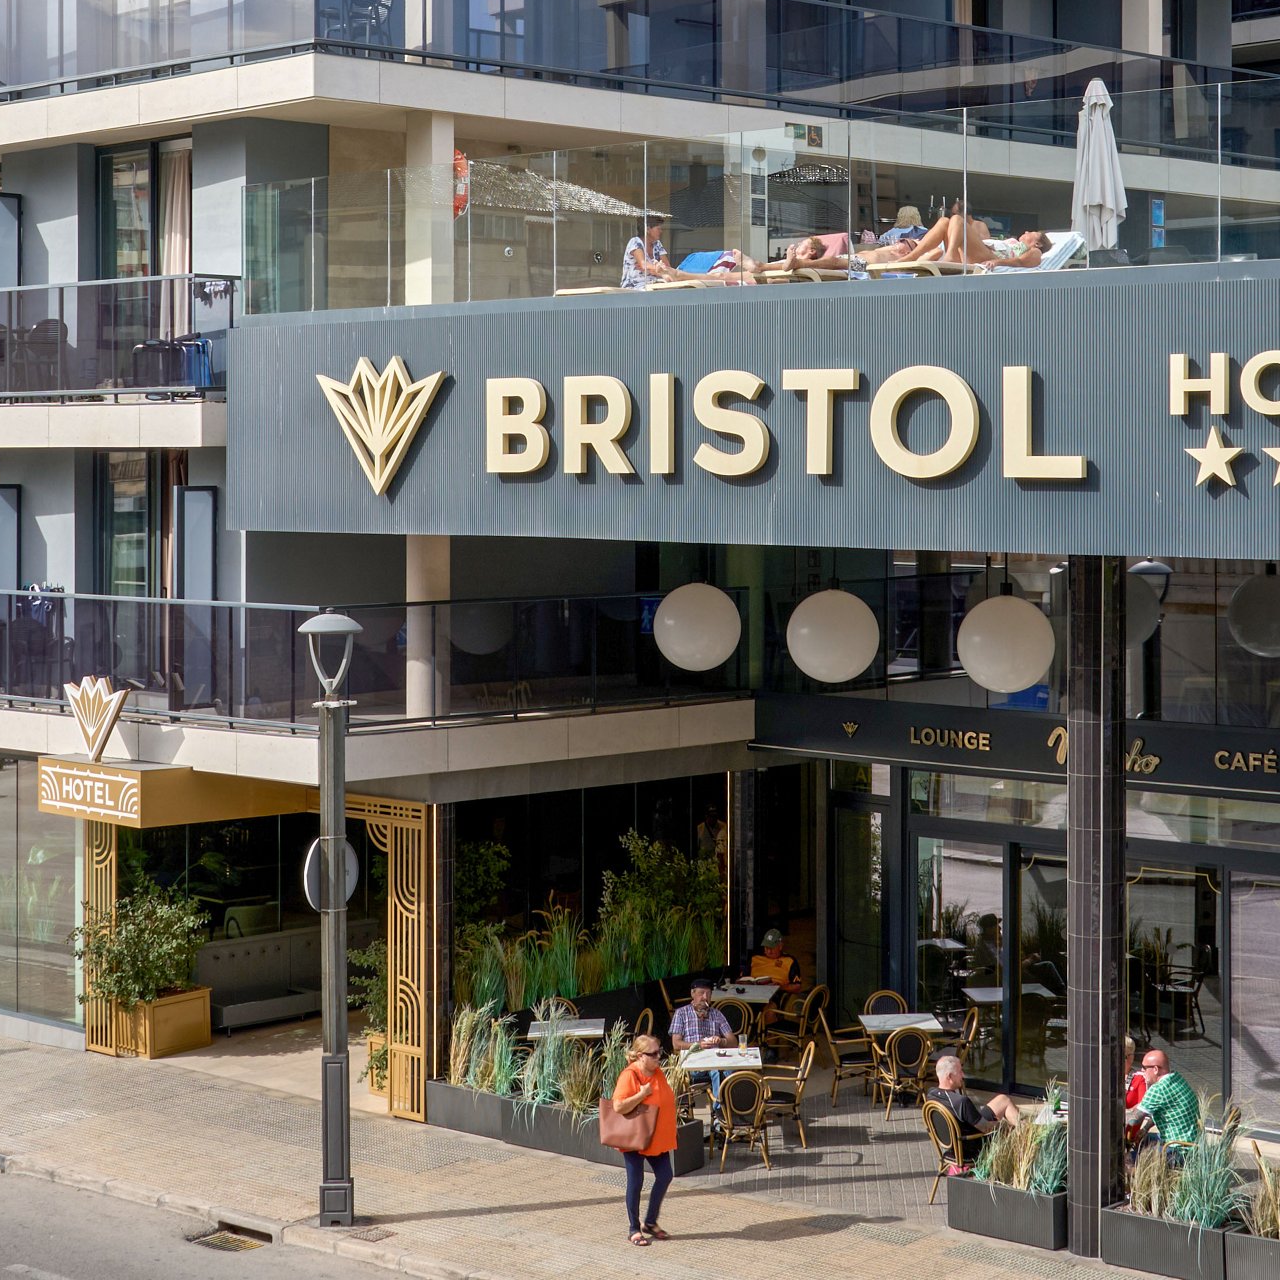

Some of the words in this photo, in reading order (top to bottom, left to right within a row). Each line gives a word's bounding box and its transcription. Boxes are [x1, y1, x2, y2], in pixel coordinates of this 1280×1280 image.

[484, 365, 1088, 483] BRISTOL
[908, 725, 992, 752] LOUNGE
[1213, 749, 1278, 775] CAFÉ
[62, 776, 115, 807] HOTEL
